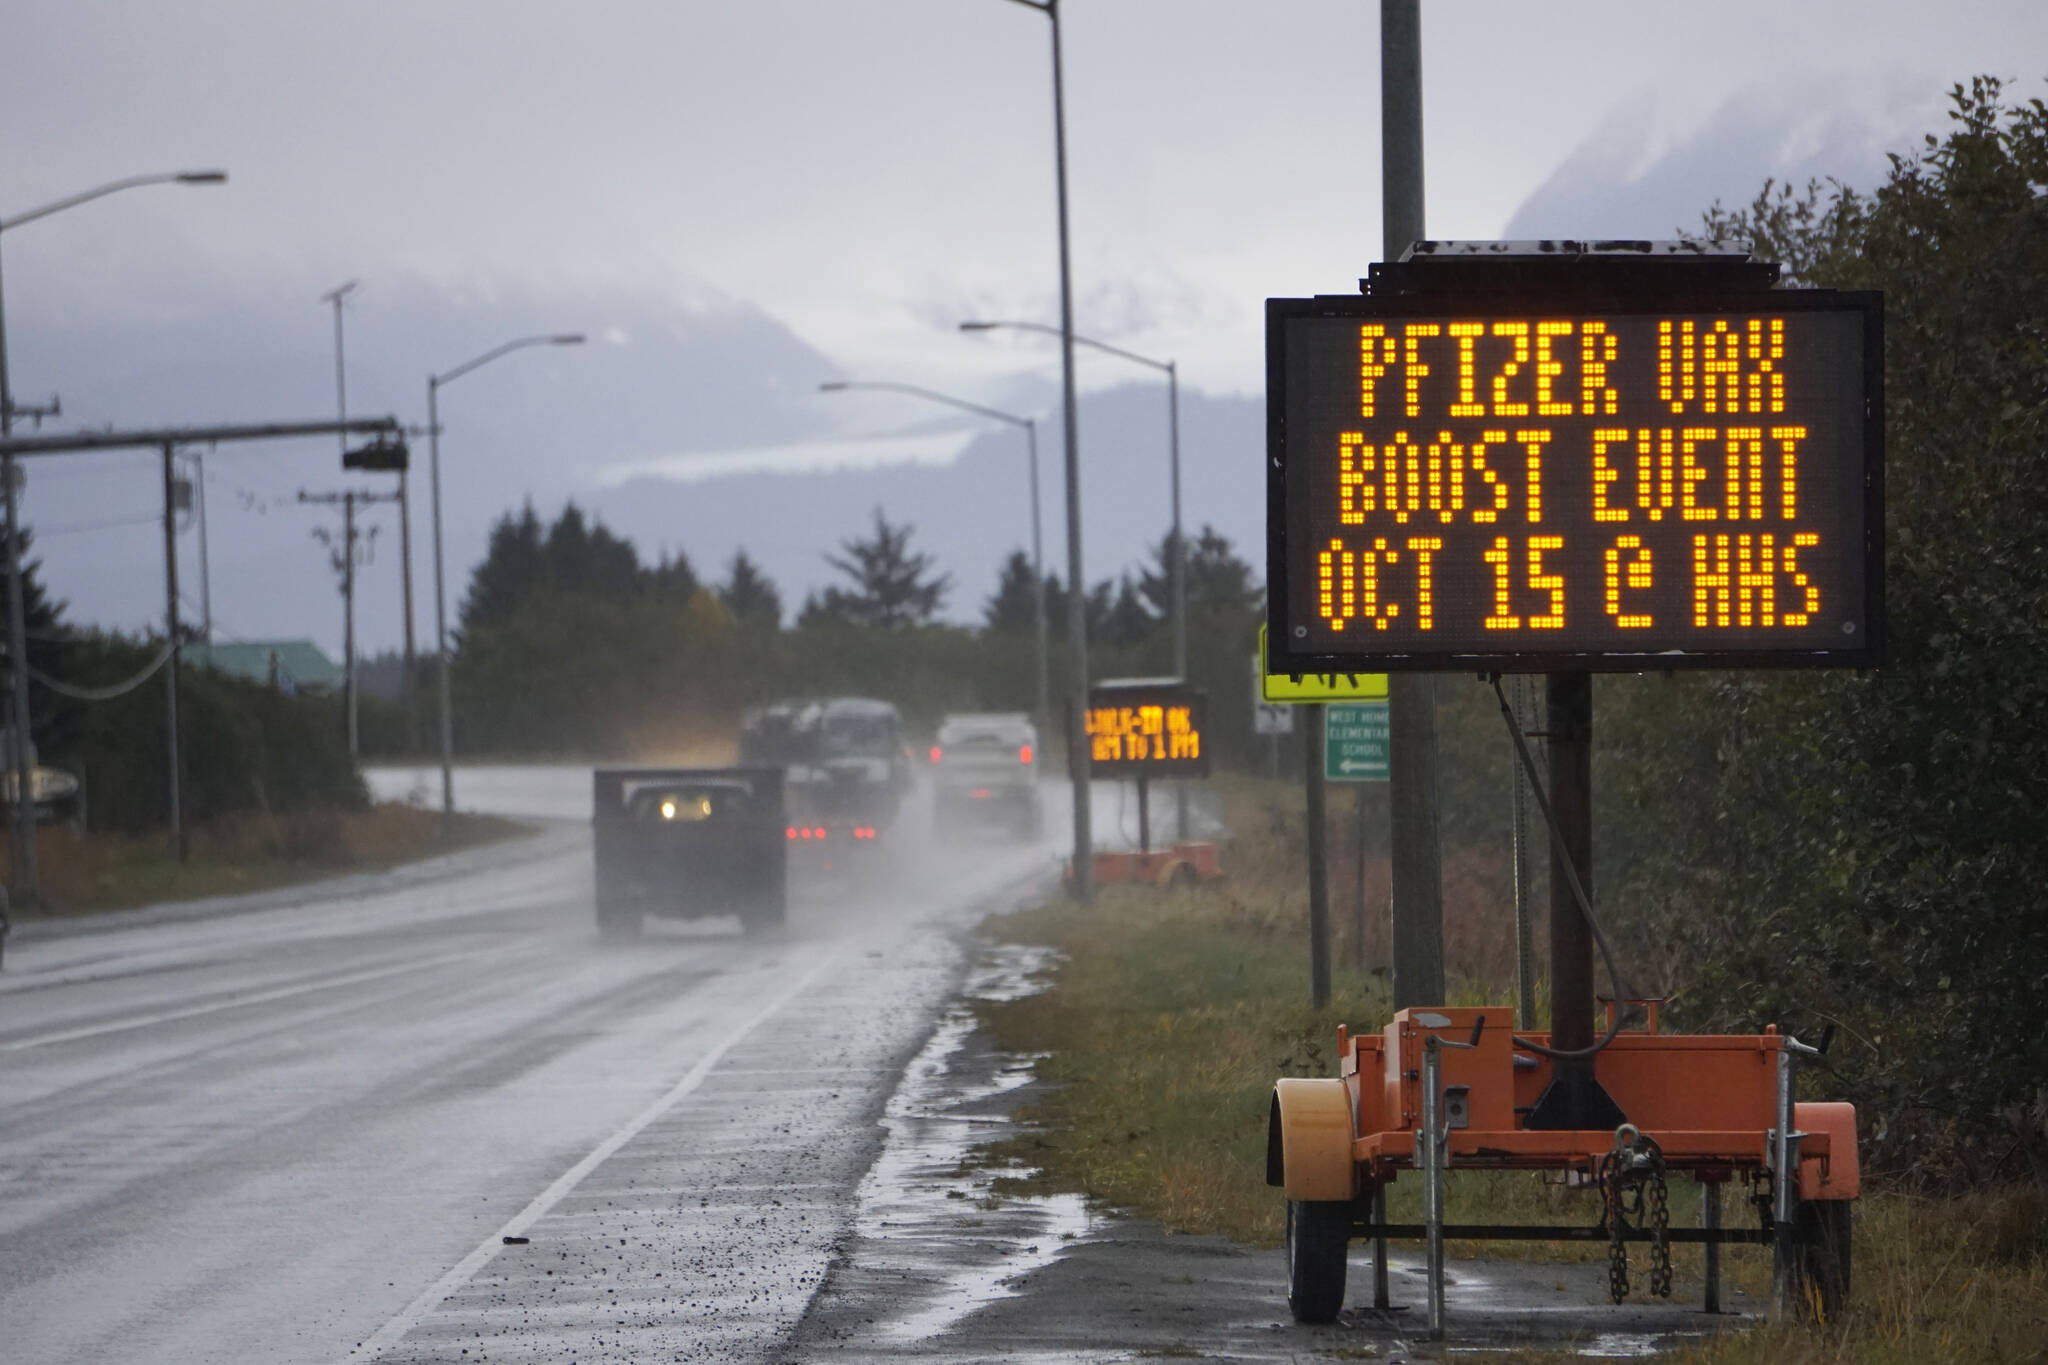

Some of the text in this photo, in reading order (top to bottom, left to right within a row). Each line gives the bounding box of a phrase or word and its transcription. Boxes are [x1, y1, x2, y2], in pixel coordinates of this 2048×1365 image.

[1361, 319, 1784, 418] PFIZER VAX
[1340, 426, 1806, 525] BOOST EVENT
[1319, 533, 1821, 631] OCT 15 @ HHS
[1329, 727, 1390, 740] ELEMENTAR
[1342, 743, 1384, 756] SCHOOL
